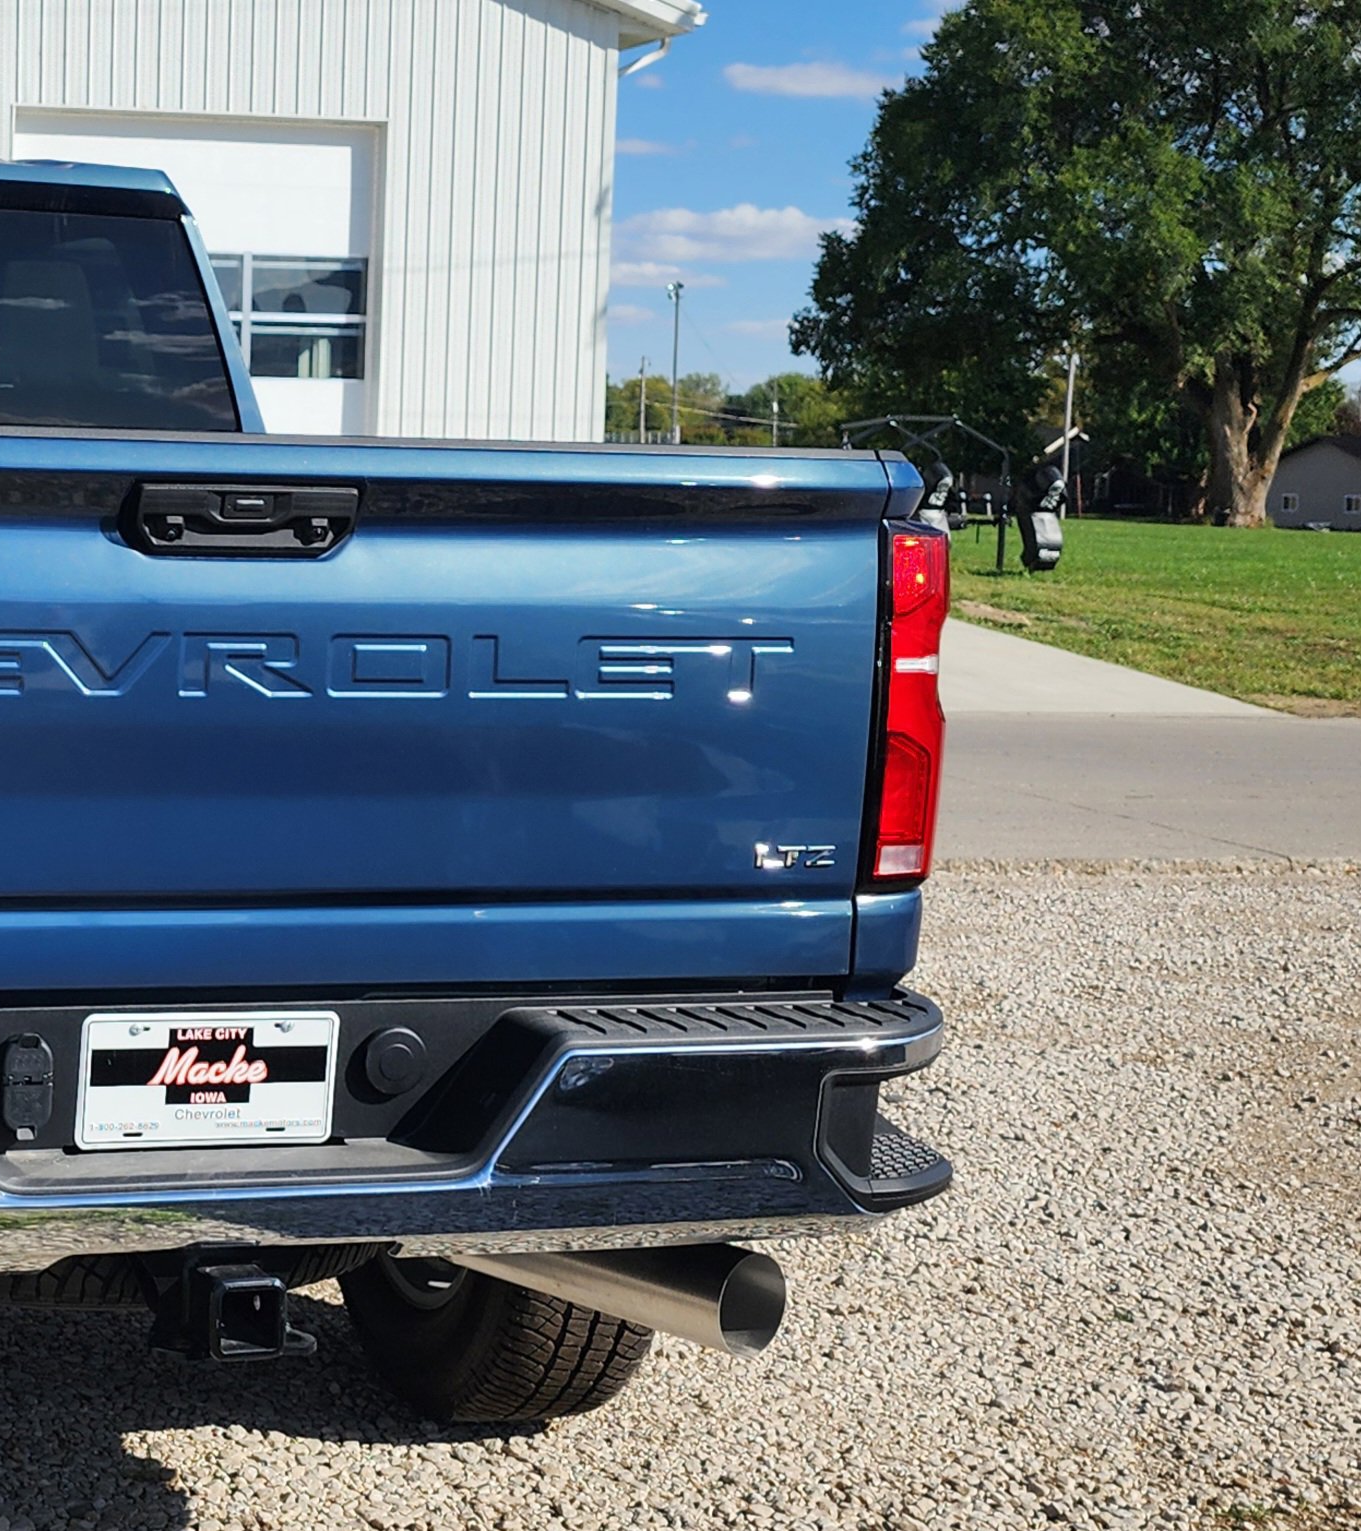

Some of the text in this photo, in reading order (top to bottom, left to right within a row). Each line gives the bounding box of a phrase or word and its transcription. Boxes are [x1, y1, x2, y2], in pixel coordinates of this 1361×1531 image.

[755, 843, 836, 869] LTZ
[177, 1027, 247, 1040] LAKE CITY
[147, 1044, 268, 1085] Macke
[190, 1092, 226, 1104] IOWA
[174, 1108, 240, 1120] Chevrolet
